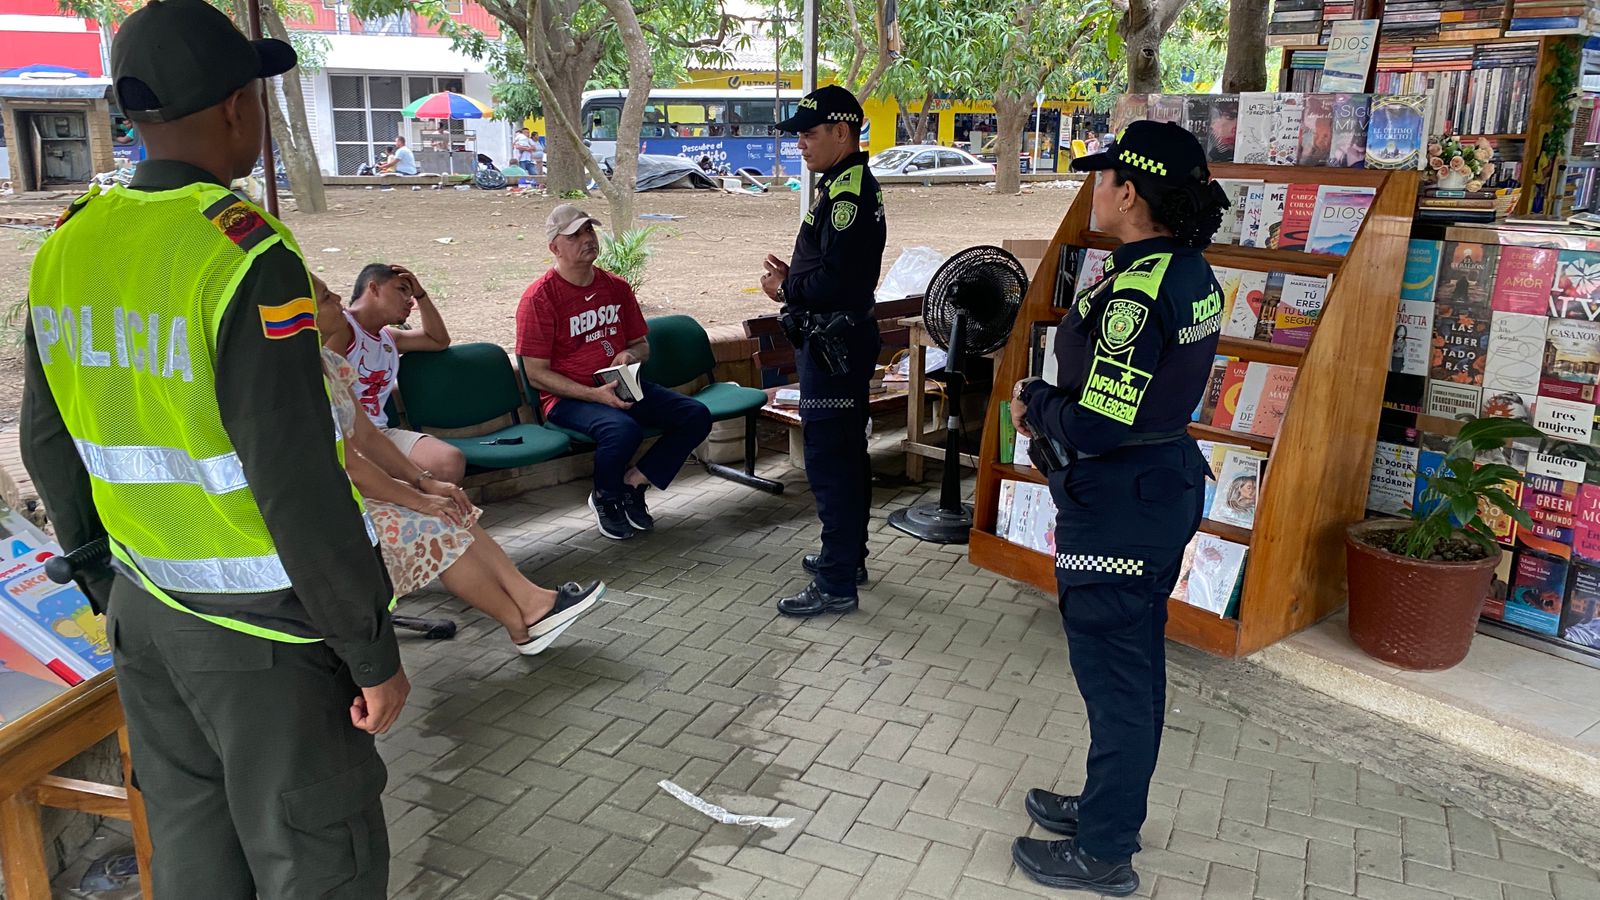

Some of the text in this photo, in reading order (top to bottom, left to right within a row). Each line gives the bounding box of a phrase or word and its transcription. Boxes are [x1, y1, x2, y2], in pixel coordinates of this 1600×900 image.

[1331, 37, 1369, 51] DIOS
[682, 141, 723, 153] Descubre el
[1323, 206, 1366, 220] DIOS
[1503, 276, 1543, 289] AMOR
[1304, 290, 1317, 300] TÚ
[1112, 301, 1143, 316] POLICÍA
[1284, 306, 1295, 315] TU
[1296, 299, 1321, 309] ERES
[569, 303, 622, 338] RED SOX
[1106, 307, 1143, 325] NACIONAL
[1451, 323, 1475, 333] LAS
[1444, 335, 1478, 347] LIBER
[1442, 348, 1476, 360] TADO
[1445, 362, 1469, 372] RAS
[1551, 410, 1576, 421] tres
[1537, 421, 1588, 436] mujeres
[1375, 457, 1412, 471] EL PODER
[1385, 469, 1400, 477] DEL
[1371, 474, 1413, 488] DESORDEN
[1527, 476, 1558, 493] JOHN
[1536, 494, 1573, 513] GREEN
[1535, 510, 1573, 526] TU MUNDO
[1536, 526, 1544, 534] EL
[1547, 527, 1562, 539] MÍO
